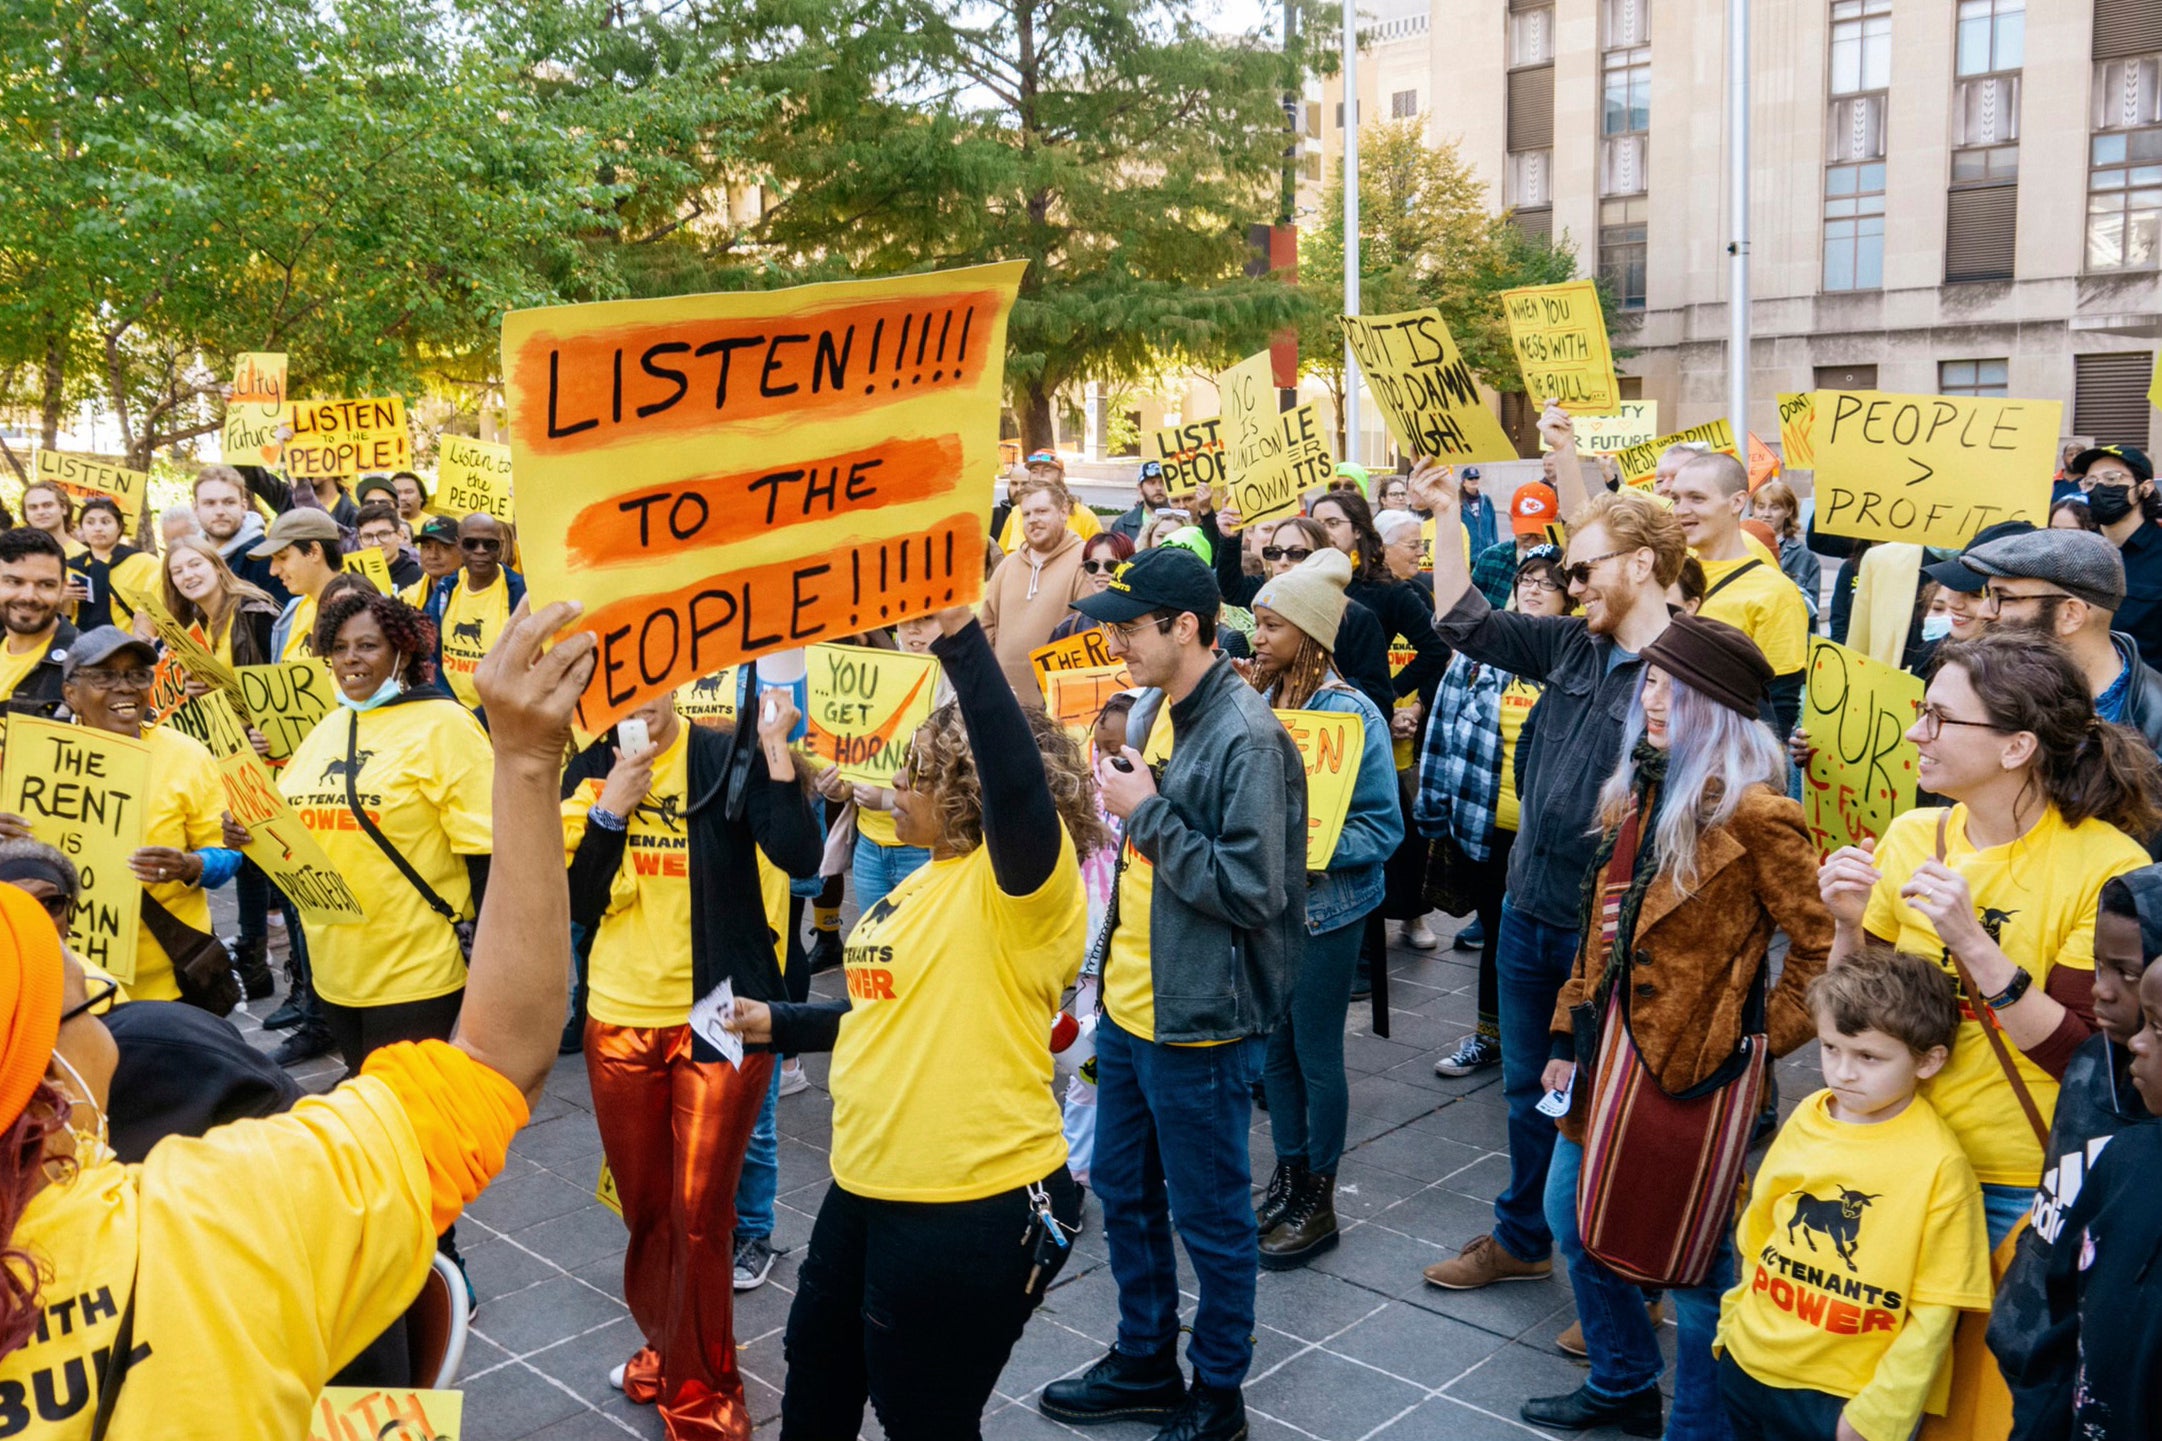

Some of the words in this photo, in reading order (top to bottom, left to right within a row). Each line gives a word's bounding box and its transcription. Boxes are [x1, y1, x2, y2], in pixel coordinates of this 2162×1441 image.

[1509, 298, 1539, 320] WHEN
[1541, 296, 1570, 324] YOU
[1396, 316, 1444, 367] IS
[1519, 334, 1548, 361] MESS
[1550, 333, 1588, 360] WITH
[547, 306, 974, 439] LISTEN!!!!!
[1404, 359, 1480, 412] DAMN
[236, 370, 281, 418] City
[1231, 373, 1255, 416] KC
[227, 417, 279, 452] Future
[293, 402, 395, 433] LISTEN
[322, 433, 336, 443] TO
[347, 431, 371, 441] THE
[1830, 395, 2024, 450] PEOPLE
[290, 438, 403, 474] PEOPLE!
[449, 443, 492, 471] Listen
[1157, 420, 1221, 459] LIST
[41, 452, 132, 493] LISTEN
[1619, 443, 1657, 477] MESS
[467, 472, 489, 491] the
[1229, 469, 1289, 516] TOWN
[450, 487, 507, 516] PEOPLE
[619, 491, 709, 548] TO
[748, 458, 884, 525] THE
[1025, 651, 1084, 671] THE
[242, 665, 326, 713] OUR
[684, 704, 733, 715] TENANTS
[824, 701, 874, 726] GET
[1810, 643, 1901, 820] OUR
[48, 736, 106, 778] THE
[20, 774, 132, 837] RENT
[308, 793, 381, 806] TENATS
[60, 832, 83, 854] IS
[79, 865, 95, 890] O
[1761, 1245, 1778, 1266] KC
[1777, 1255, 1902, 1310] TENANTS
[36, 1285, 118, 1344] ITH
[1752, 1263, 1897, 1336] POWER
